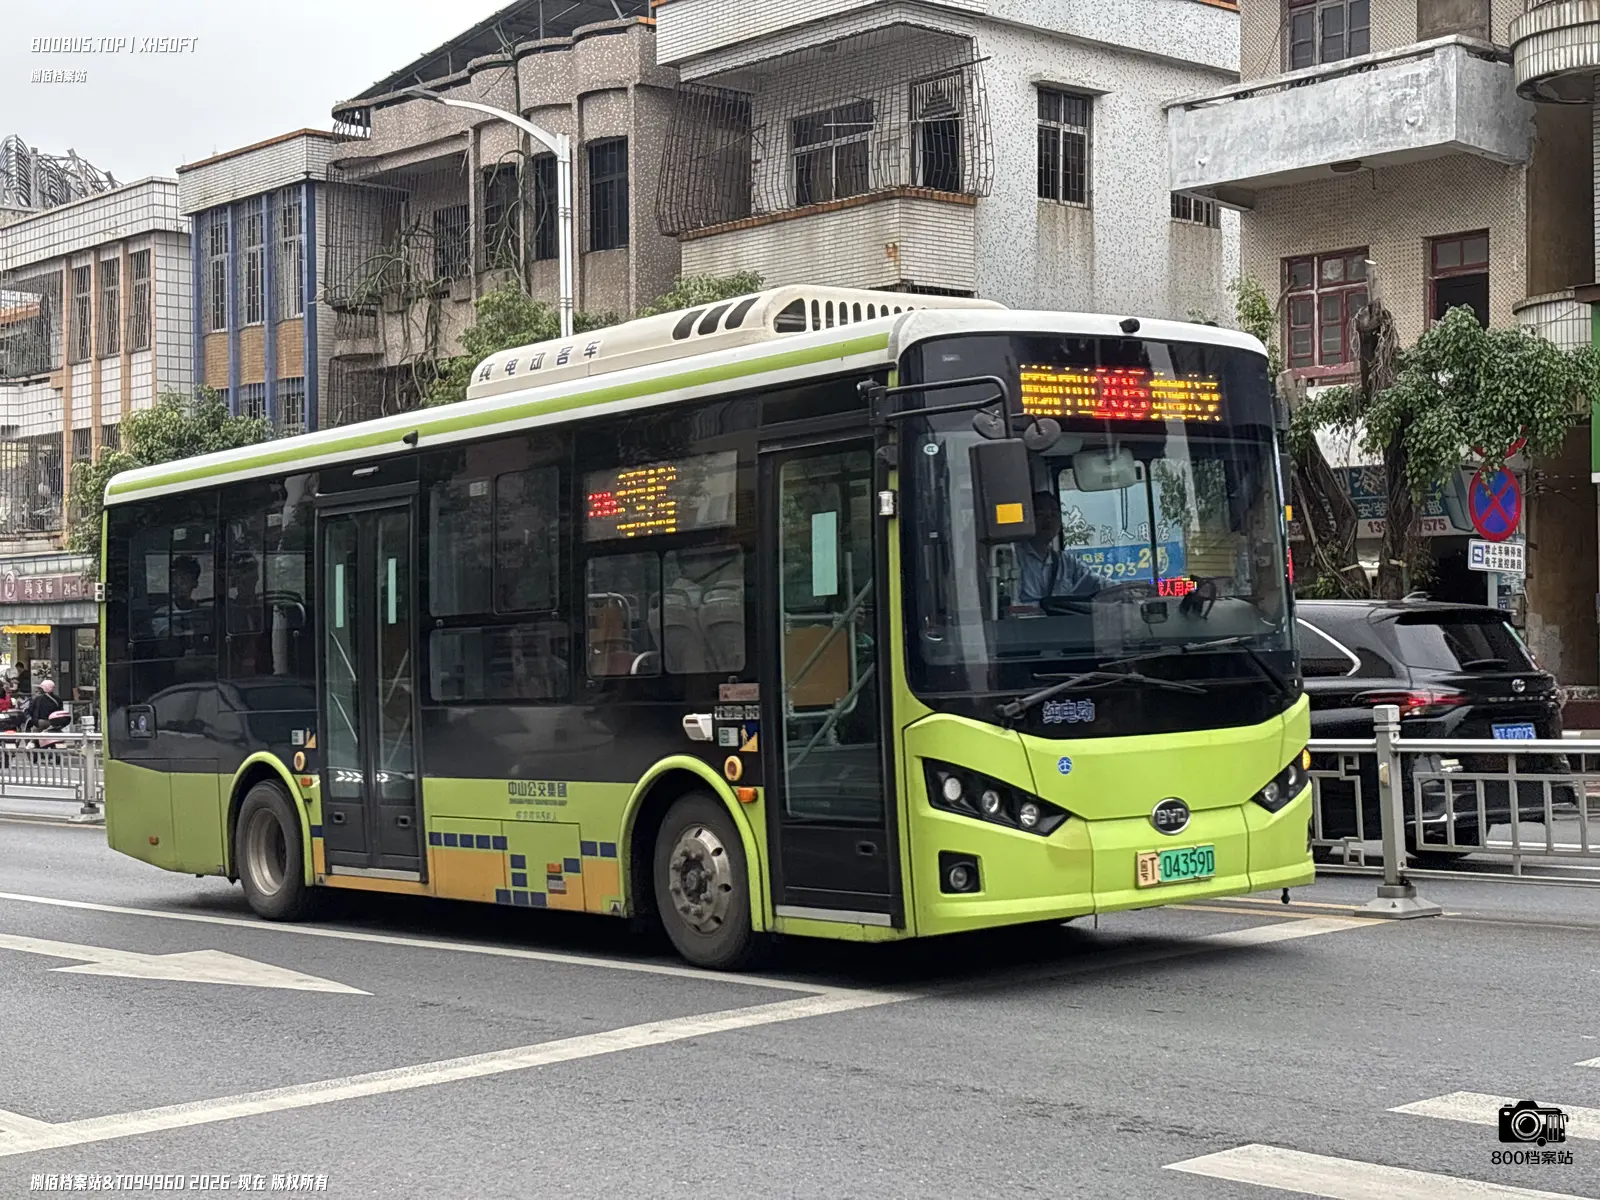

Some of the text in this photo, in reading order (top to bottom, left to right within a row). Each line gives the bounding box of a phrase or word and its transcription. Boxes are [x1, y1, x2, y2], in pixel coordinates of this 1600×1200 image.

[479, 340, 602, 382] 纯电动客车
[1043, 698, 1095, 724] 纯电动
[508, 781, 567, 797] 中山公交集团
[1156, 807, 1187, 825] BYD
[1163, 849, 1215, 878] 04359D
